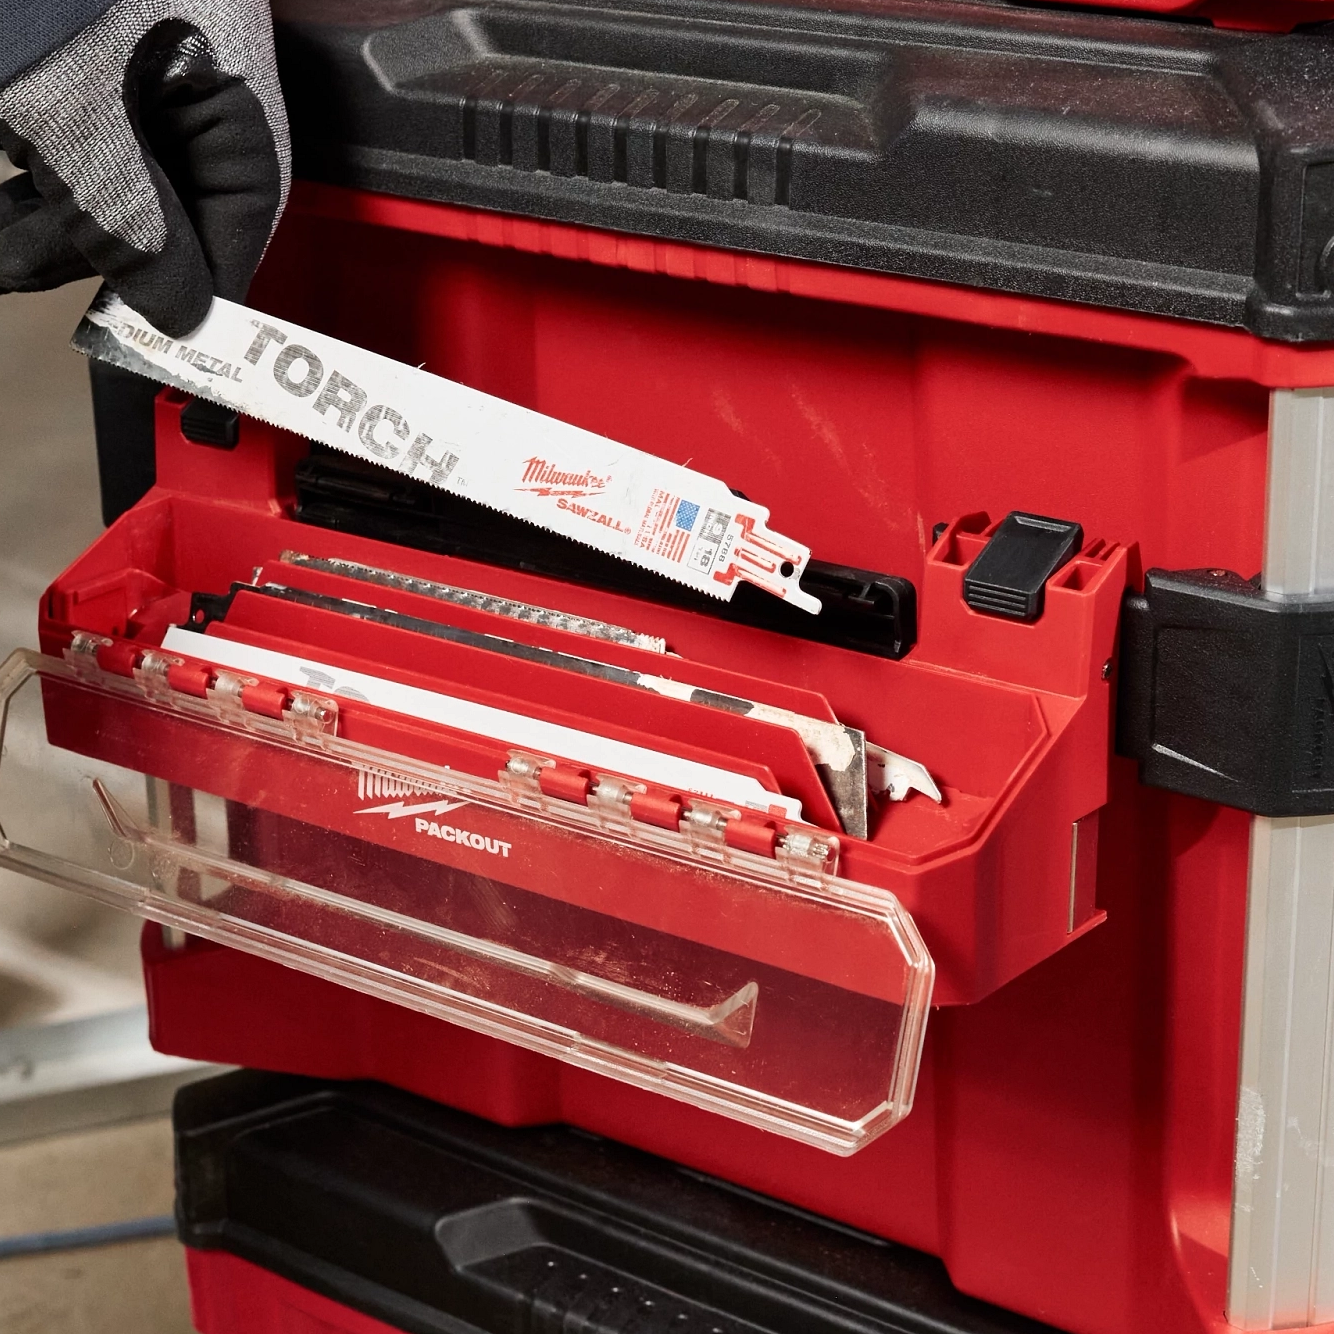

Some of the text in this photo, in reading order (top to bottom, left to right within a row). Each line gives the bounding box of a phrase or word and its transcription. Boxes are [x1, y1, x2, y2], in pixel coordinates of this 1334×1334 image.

[174, 345, 244, 383] METAL
[717, 532, 734, 563] 5788
[414, 817, 512, 858] PACKOUT
